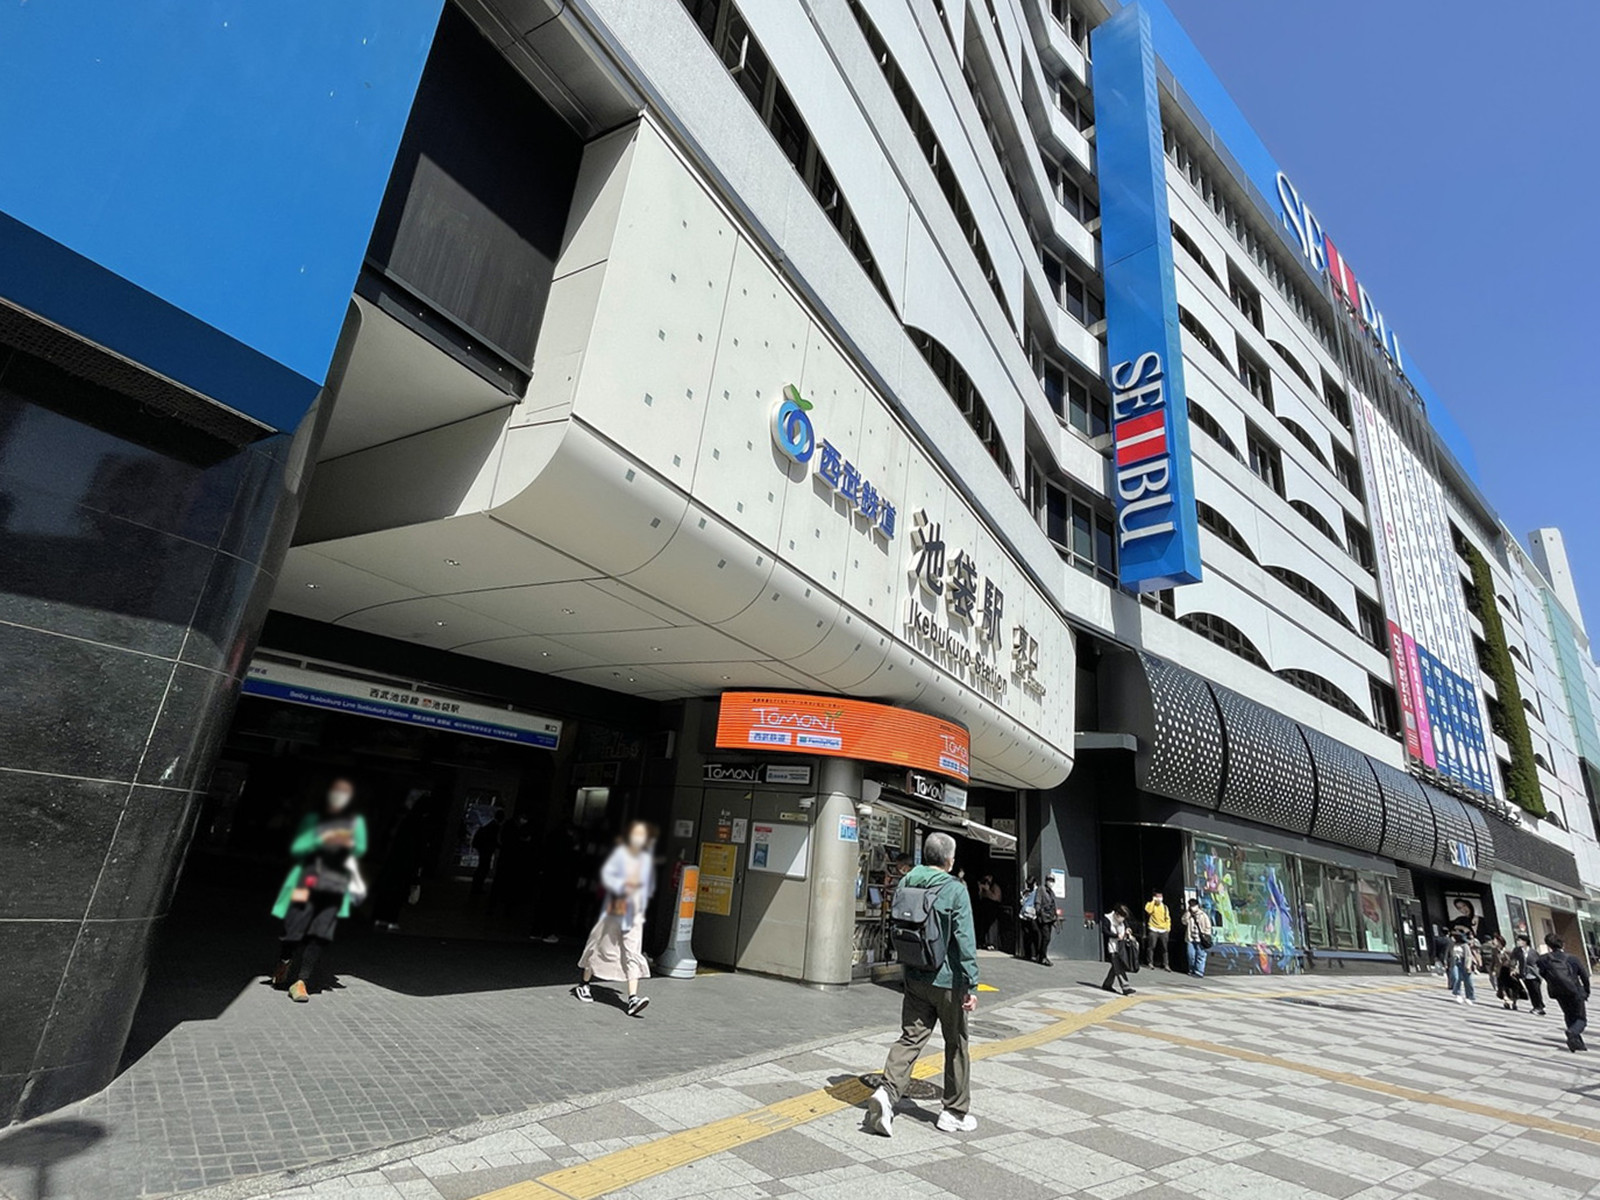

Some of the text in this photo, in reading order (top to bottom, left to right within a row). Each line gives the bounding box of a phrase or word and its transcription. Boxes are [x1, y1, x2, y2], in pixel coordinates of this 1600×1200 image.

[816, 438, 897, 540] 西武鉄道
[1111, 351, 1176, 549] SEIBU
[909, 508, 1004, 650] 池袋駅
[908, 597, 1008, 696] Ikebukuro Station
[1012, 624, 1039, 671] 東口
[369, 687, 461, 714] 西武池袋線 池袋駅
[702, 763, 766, 781] TOMONY
